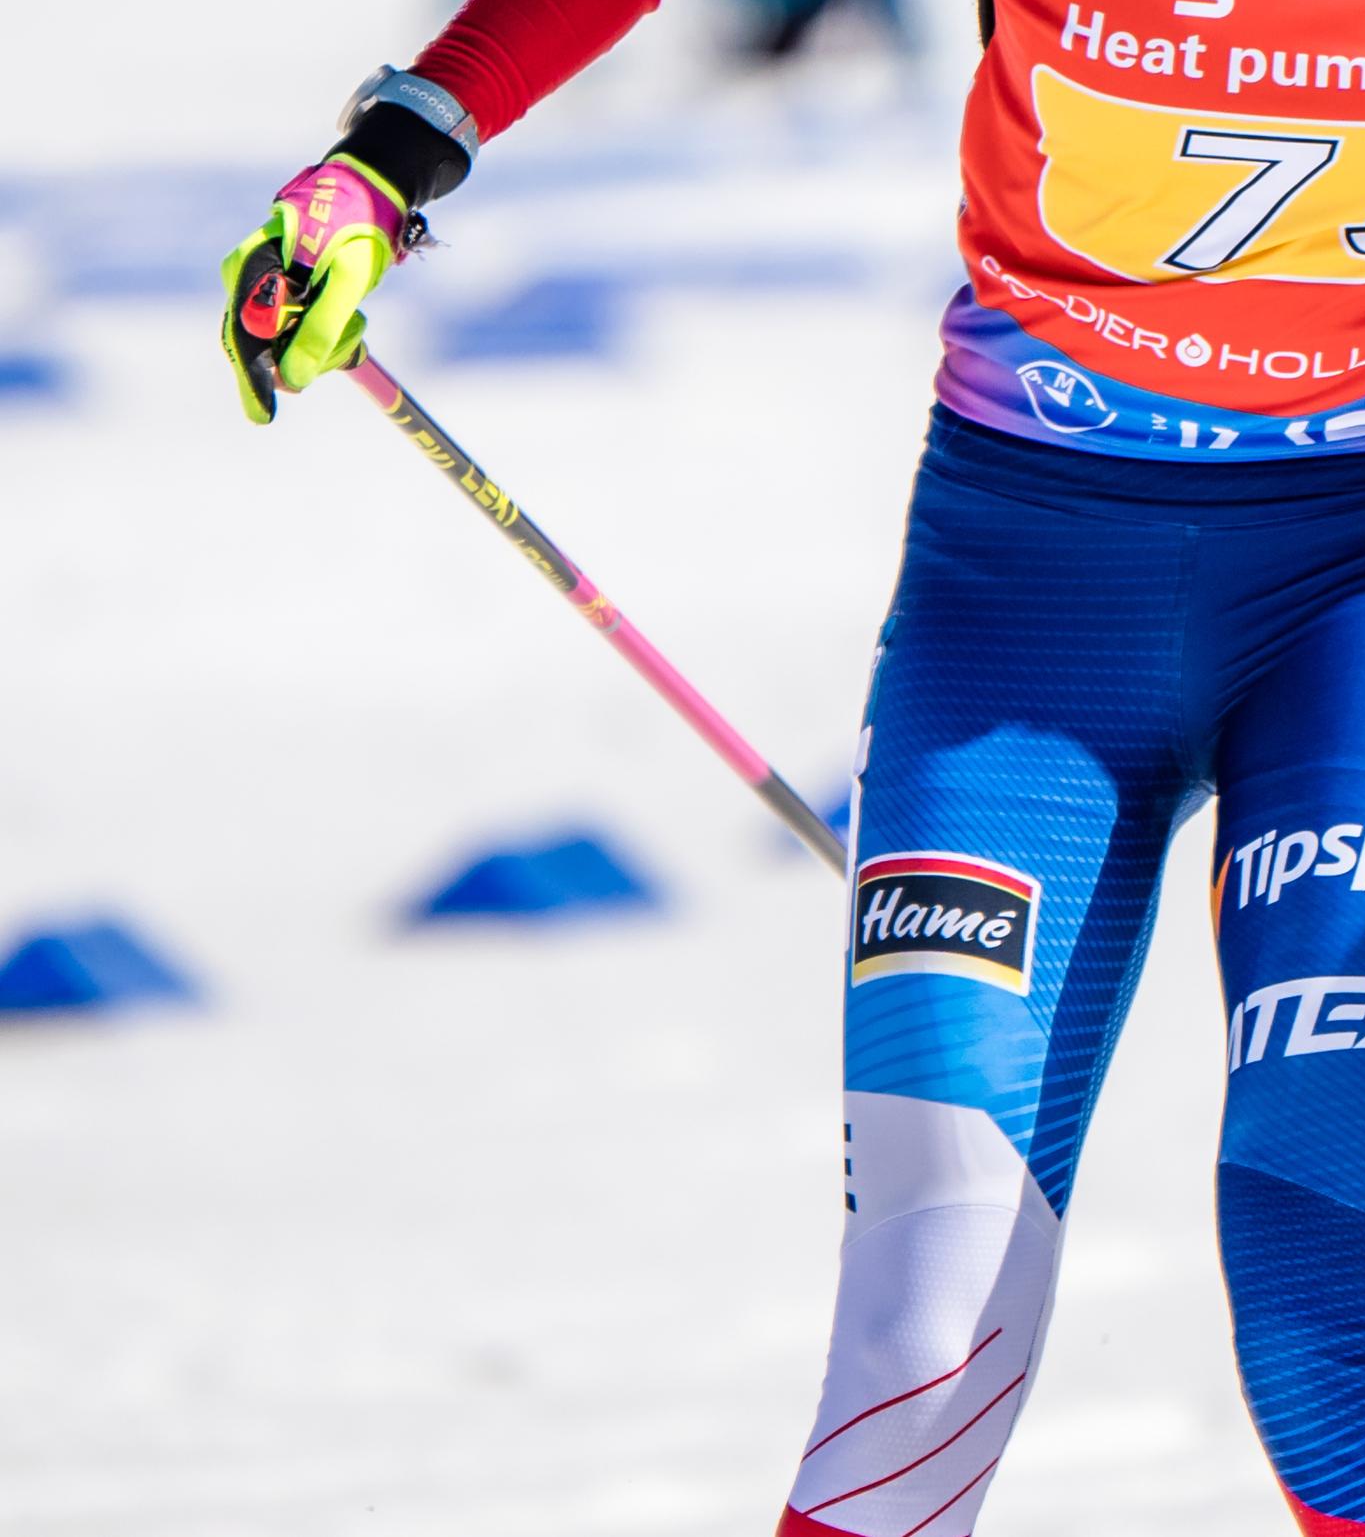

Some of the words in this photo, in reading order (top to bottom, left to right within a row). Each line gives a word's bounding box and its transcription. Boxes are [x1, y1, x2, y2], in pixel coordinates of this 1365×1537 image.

[1060, 3, 1205, 80] Heat
[299, 176, 338, 260] LEKI
[1156, 126, 1344, 272] 7
[861, 887, 1020, 950] Hamé
